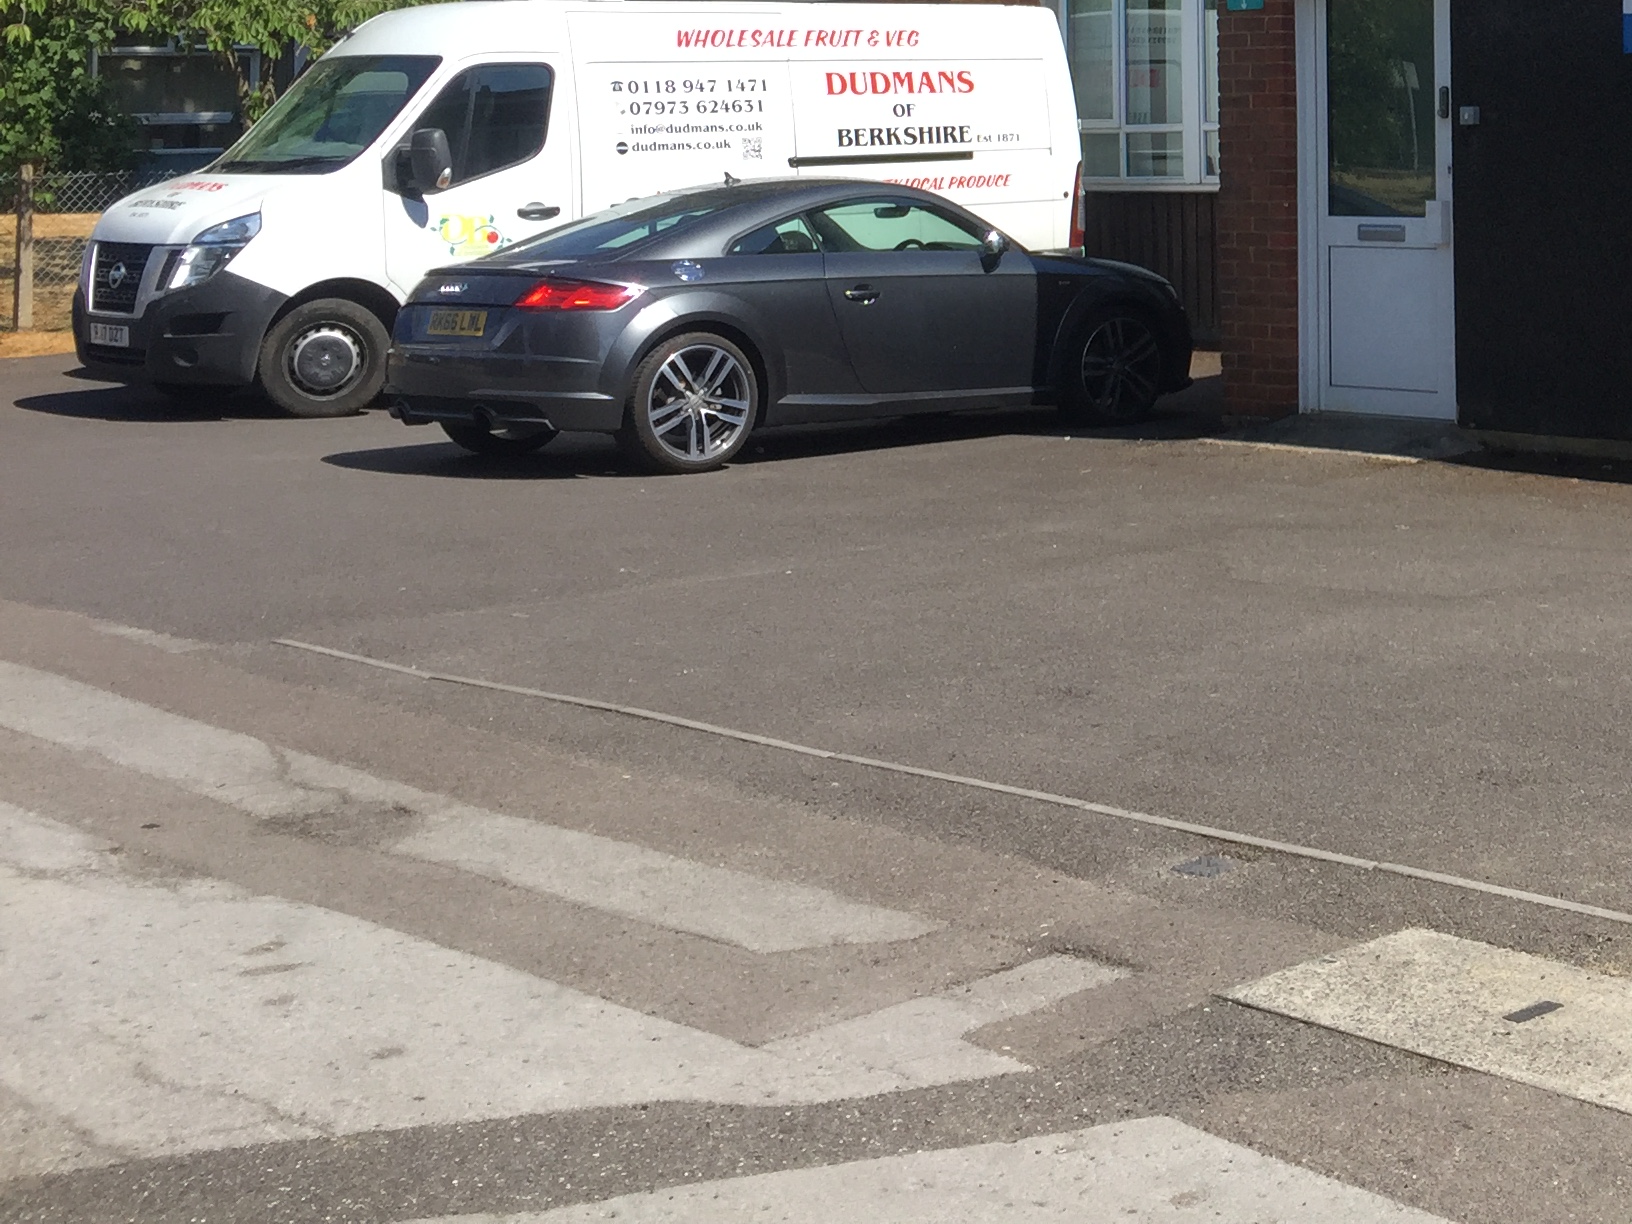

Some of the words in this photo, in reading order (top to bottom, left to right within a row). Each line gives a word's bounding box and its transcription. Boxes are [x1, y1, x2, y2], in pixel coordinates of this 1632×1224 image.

[676, 29, 799, 48] WHOLESALE
[803, 29, 864, 48] FRUIT
[867, 29, 880, 47] &
[886, 29, 920, 48] VEG
[628, 79, 677, 94] 0118
[682, 79, 717, 94] 947
[728, 79, 768, 93] 1471
[825, 70, 975, 96] DUDMANS
[629, 101, 690, 116] 07973
[696, 99, 764, 114] 624631
[892, 103, 916, 118] OF
[630, 122, 764, 135] info@dudmans.co.uk
[837, 125, 973, 148] BERKSHIRE
[976, 133, 993, 143] Est
[997, 133, 1021, 143] 1871
[632, 139, 732, 152] dudmans.co.uk
[948, 173, 1013, 190] PRODUCE
